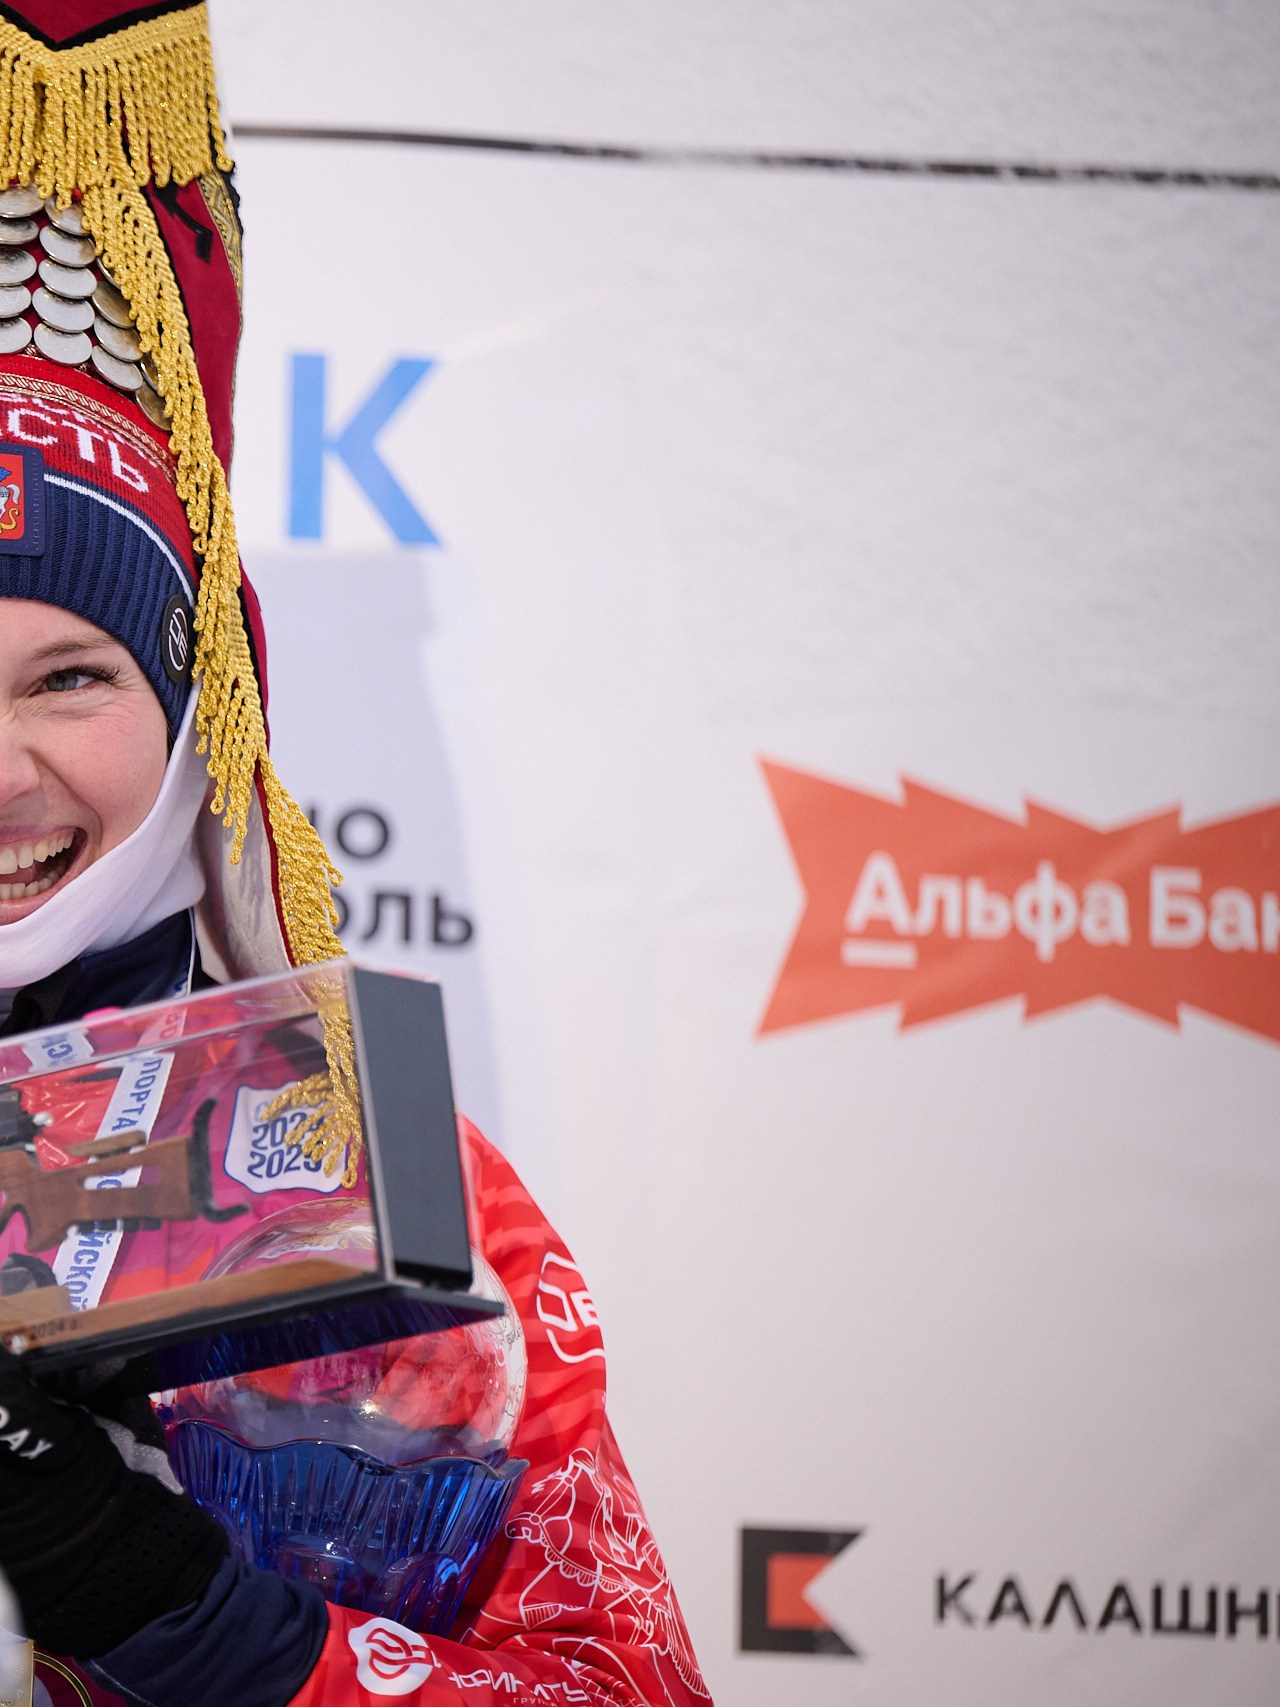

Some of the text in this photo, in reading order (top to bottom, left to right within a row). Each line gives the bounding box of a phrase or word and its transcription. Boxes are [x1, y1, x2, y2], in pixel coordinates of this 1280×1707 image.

[842, 850, 1132, 966] Альфа
[111, 1056, 163, 1132] ПОРТА
[934, 1572, 1280, 1640] КАЛАШН
